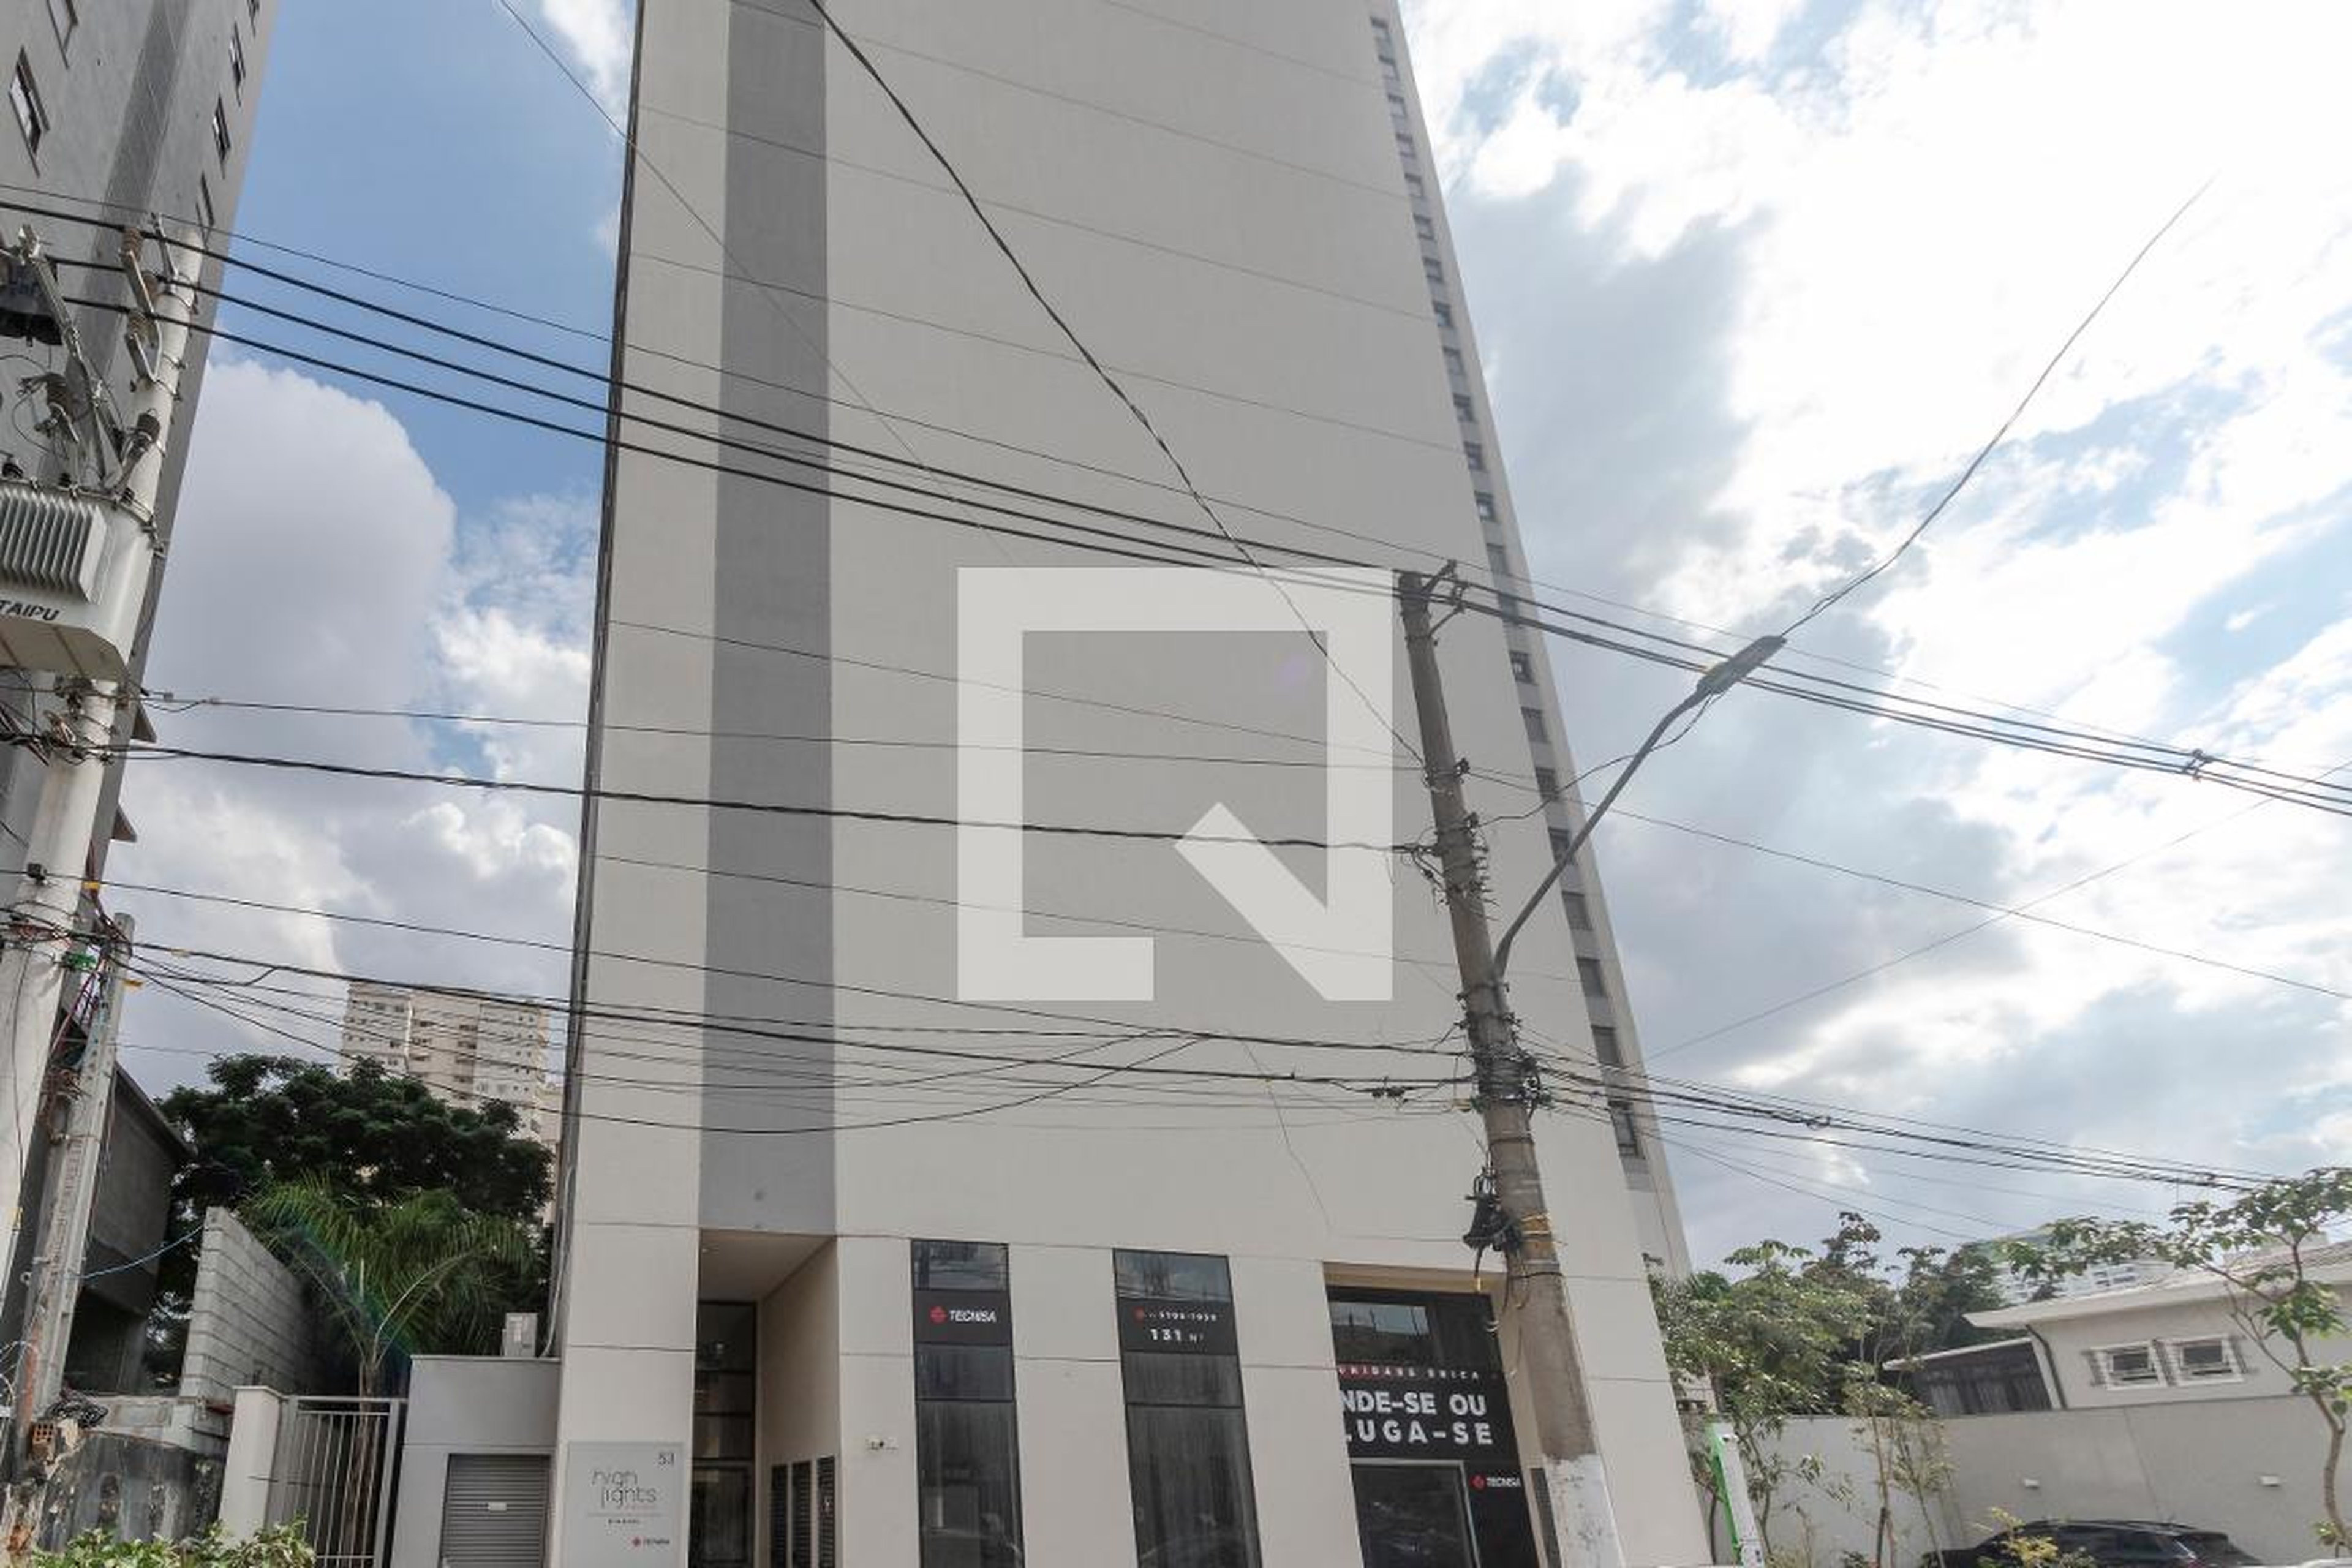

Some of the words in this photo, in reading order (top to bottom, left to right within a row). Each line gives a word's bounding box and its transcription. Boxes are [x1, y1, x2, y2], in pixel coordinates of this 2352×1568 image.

[949, 1310, 997, 1323] TECNISA
[1449, 1393, 1487, 1416] OU
[1346, 1420, 1493, 1445] UGA-SE
